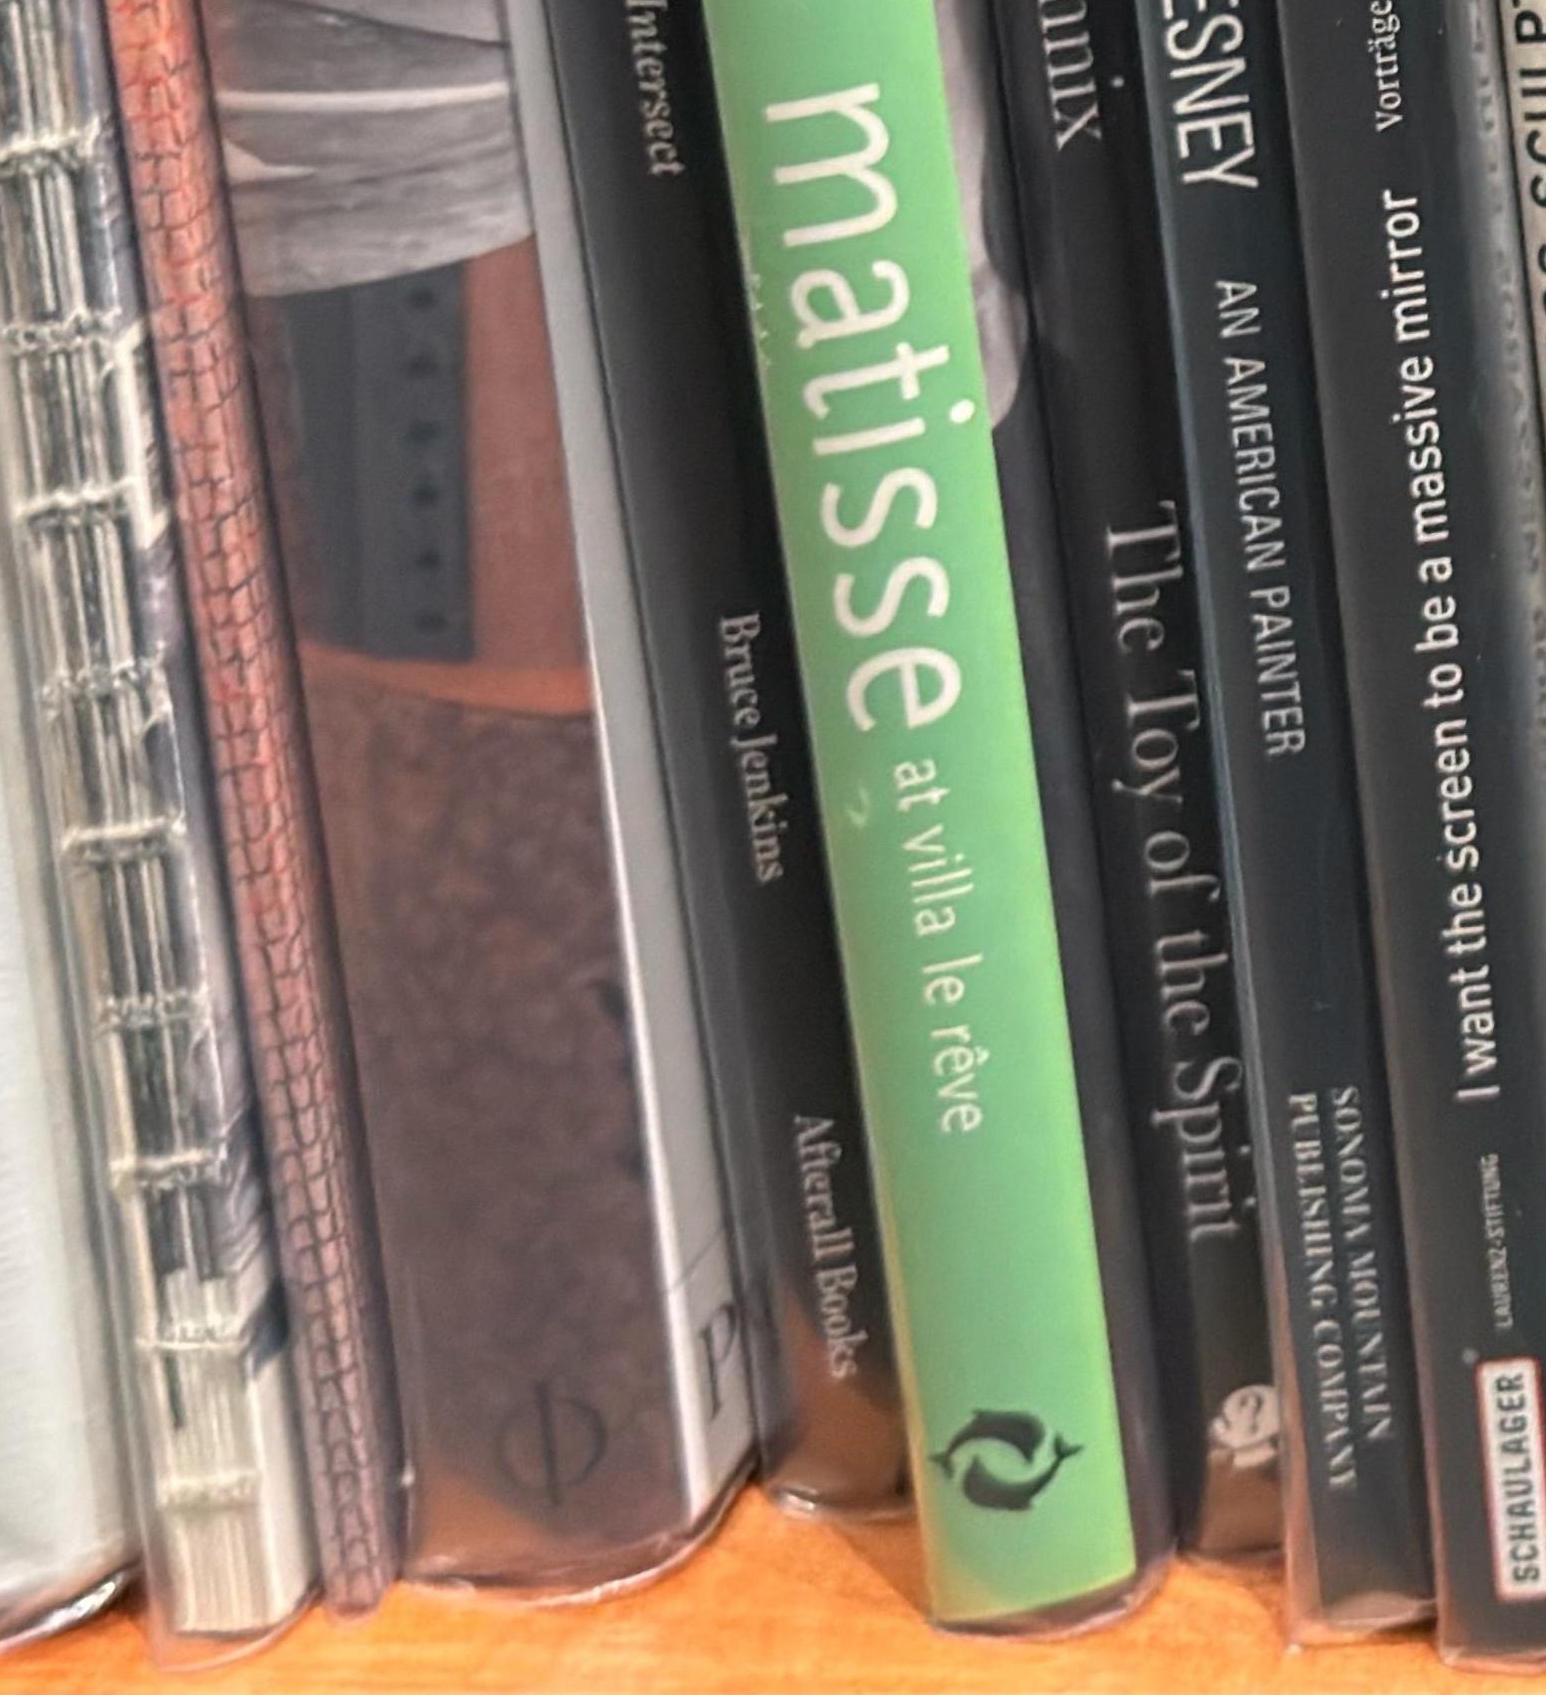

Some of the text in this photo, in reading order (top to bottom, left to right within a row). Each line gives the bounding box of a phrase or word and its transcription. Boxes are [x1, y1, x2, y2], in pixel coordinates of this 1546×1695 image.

[1366, 0, 1403, 133] Vorträge
[765, 82, 990, 1134] matisse at villa le rêve
[1215, 280, 1306, 758] AN AMERICAN PAINTER
[1381, 190, 1500, 1101] I want the screen to be a massive mirror
[719, 613, 790, 885] Bruce Jenkins
[1106, 500, 1258, 1242] The Toy of the Spirit
[794, 1114, 869, 1379] Afterall Books
[1287, 1092, 1360, 1489] PUBLISHING COMPANY
[1328, 1085, 1393, 1445] SONOMA MOUNTAIN
[1493, 1371, 1541, 1586] SCHAULAGER
